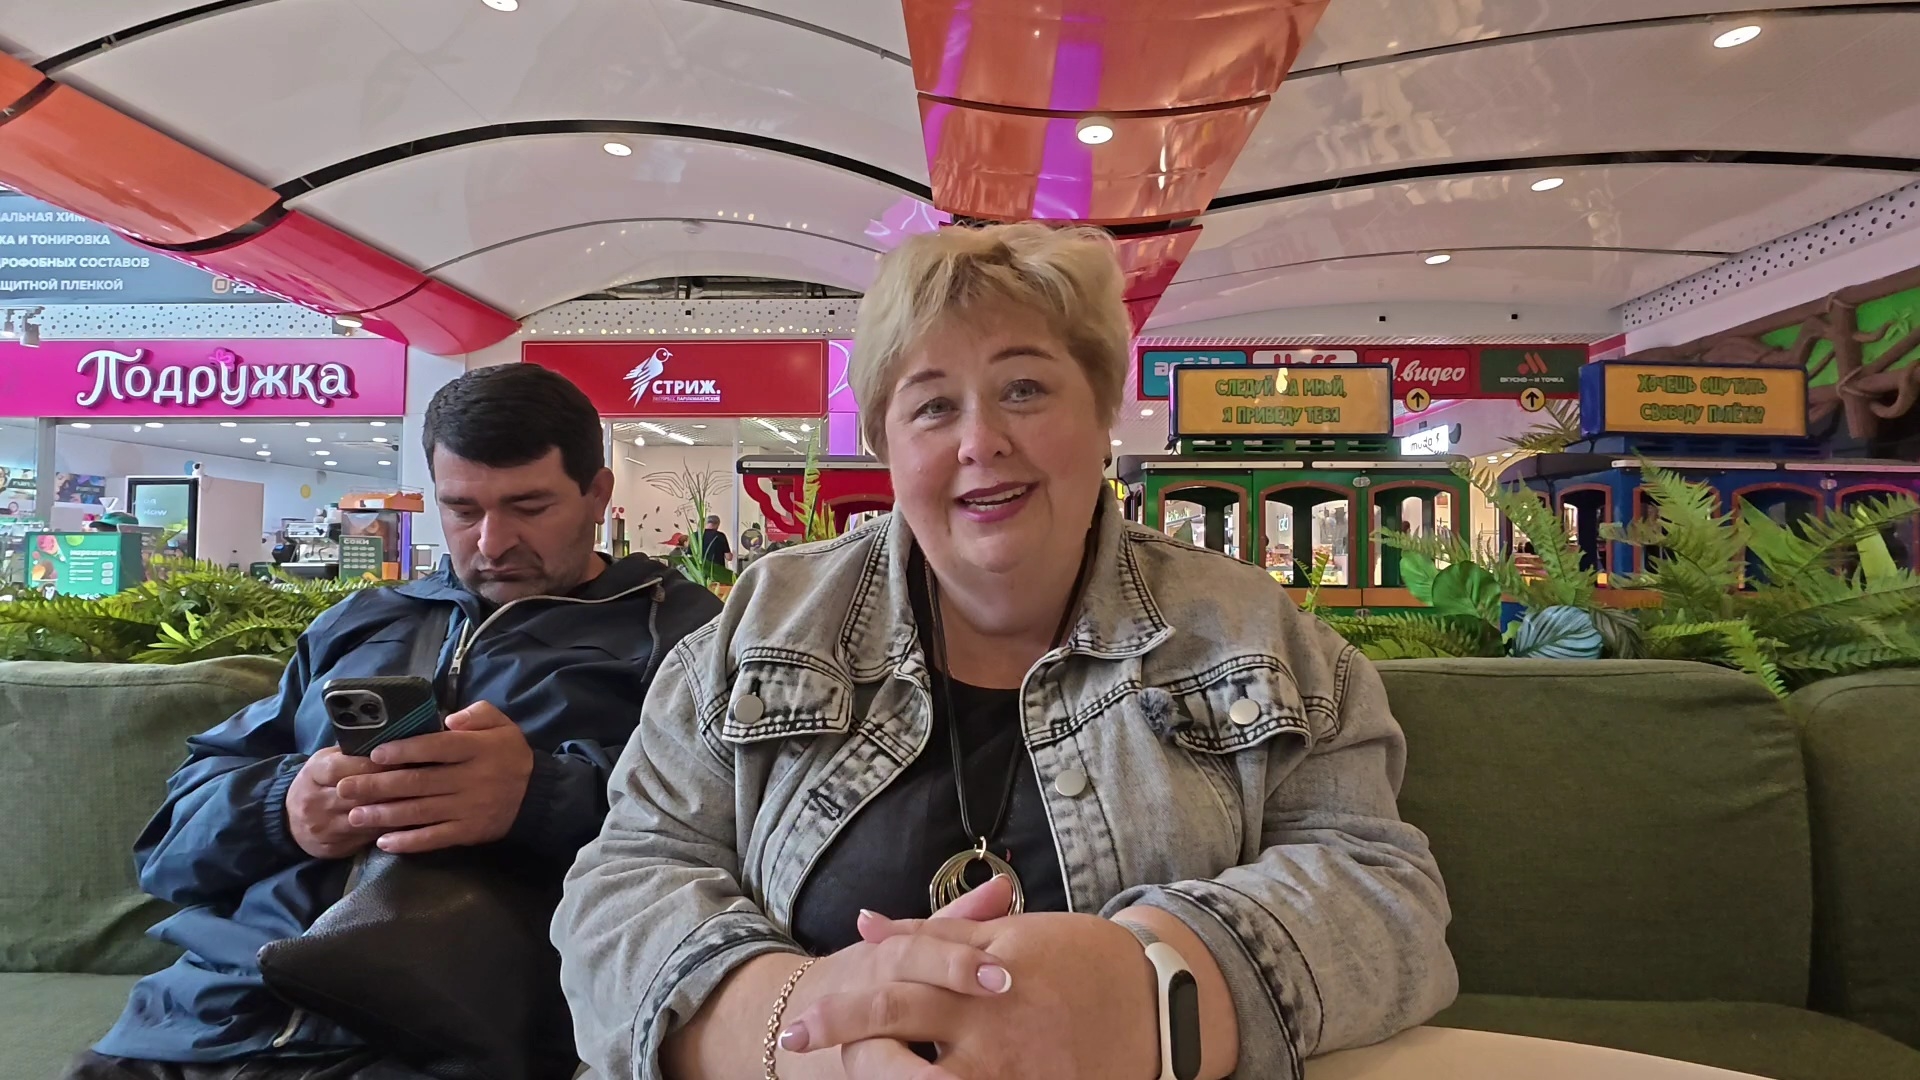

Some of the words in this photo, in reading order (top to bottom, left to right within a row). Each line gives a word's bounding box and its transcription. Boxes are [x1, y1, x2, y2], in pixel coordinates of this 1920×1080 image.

[1, 212, 53, 222] АЛЬНАЯ
[18, 235, 28, 245] И
[30, 235, 110, 245] ТОНИРОВКА
[0, 257, 76, 269] РОФОБНЫХ
[79, 257, 150, 268] СОСТАВОВ
[60, 278, 123, 290] ПЛЕНКОЙ
[76, 348, 352, 406] Подружка
[1637, 374, 1697, 394] ХОЧЕШЬ
[1700, 376, 1767, 396] ОЩУТИТЬ
[652, 379, 721, 395] СТРИЖ.
[1215, 375, 1275, 398] СЛЕДУЙ
[1302, 375, 1348, 398] МНОЙ,
[1222, 407, 1233, 423] Я
[1236, 406, 1302, 426] ПРИВЕДУ
[1305, 406, 1341, 424] ТЕБЯ
[1640, 402, 1704, 425] СВОБОДУ
